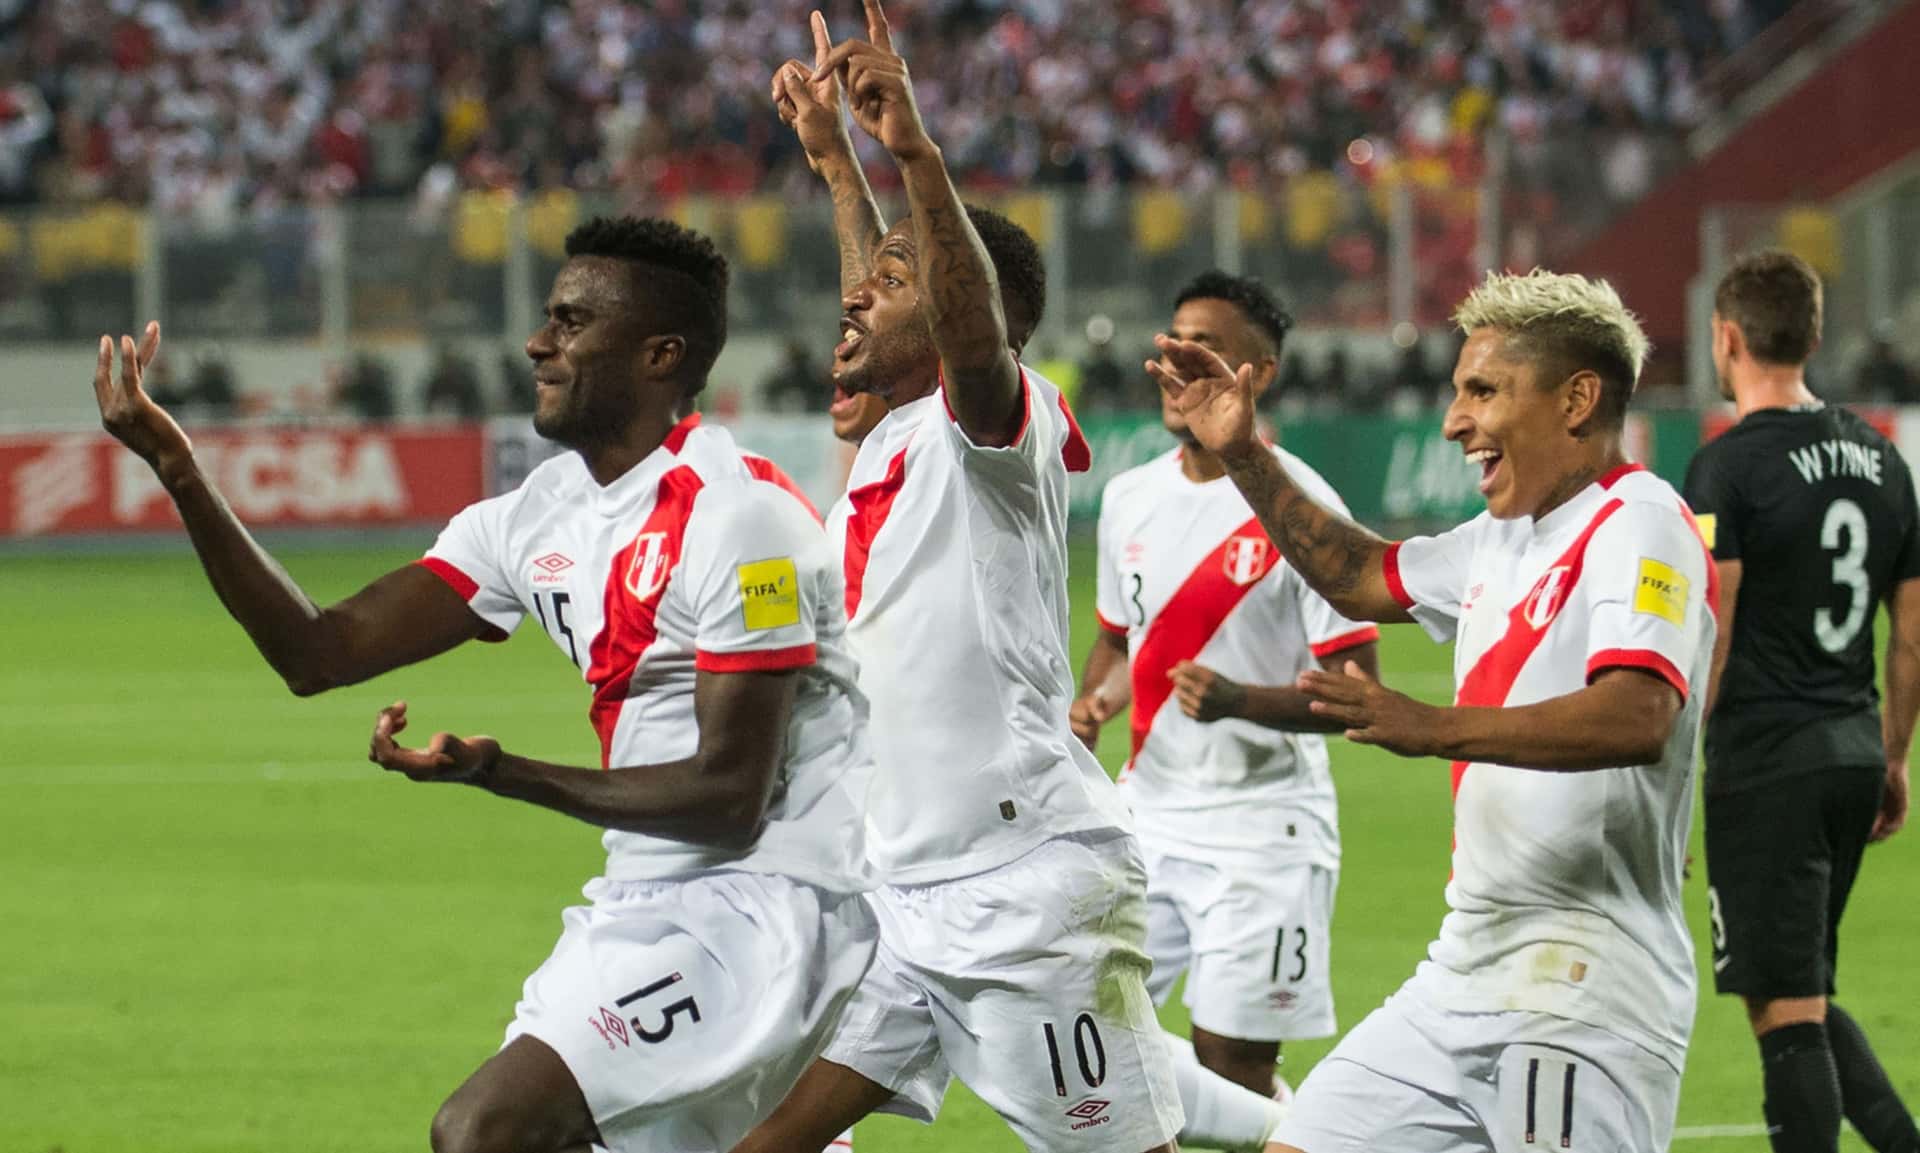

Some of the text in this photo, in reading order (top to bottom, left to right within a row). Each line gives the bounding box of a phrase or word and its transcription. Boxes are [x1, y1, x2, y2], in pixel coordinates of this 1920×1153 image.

[112, 437, 409, 520] PCSA
[1788, 439, 1883, 487] WYNNE
[744, 582, 777, 598] FIFA
[1641, 576, 1671, 594] FIFA
[1814, 498, 1870, 652] 3
[1271, 926, 1307, 983] 13
[616, 971, 701, 1044] 15
[1043, 1012, 1107, 1097] 10
[1071, 1115, 1111, 1130] umbro
[1525, 1058, 1576, 1148] 11
